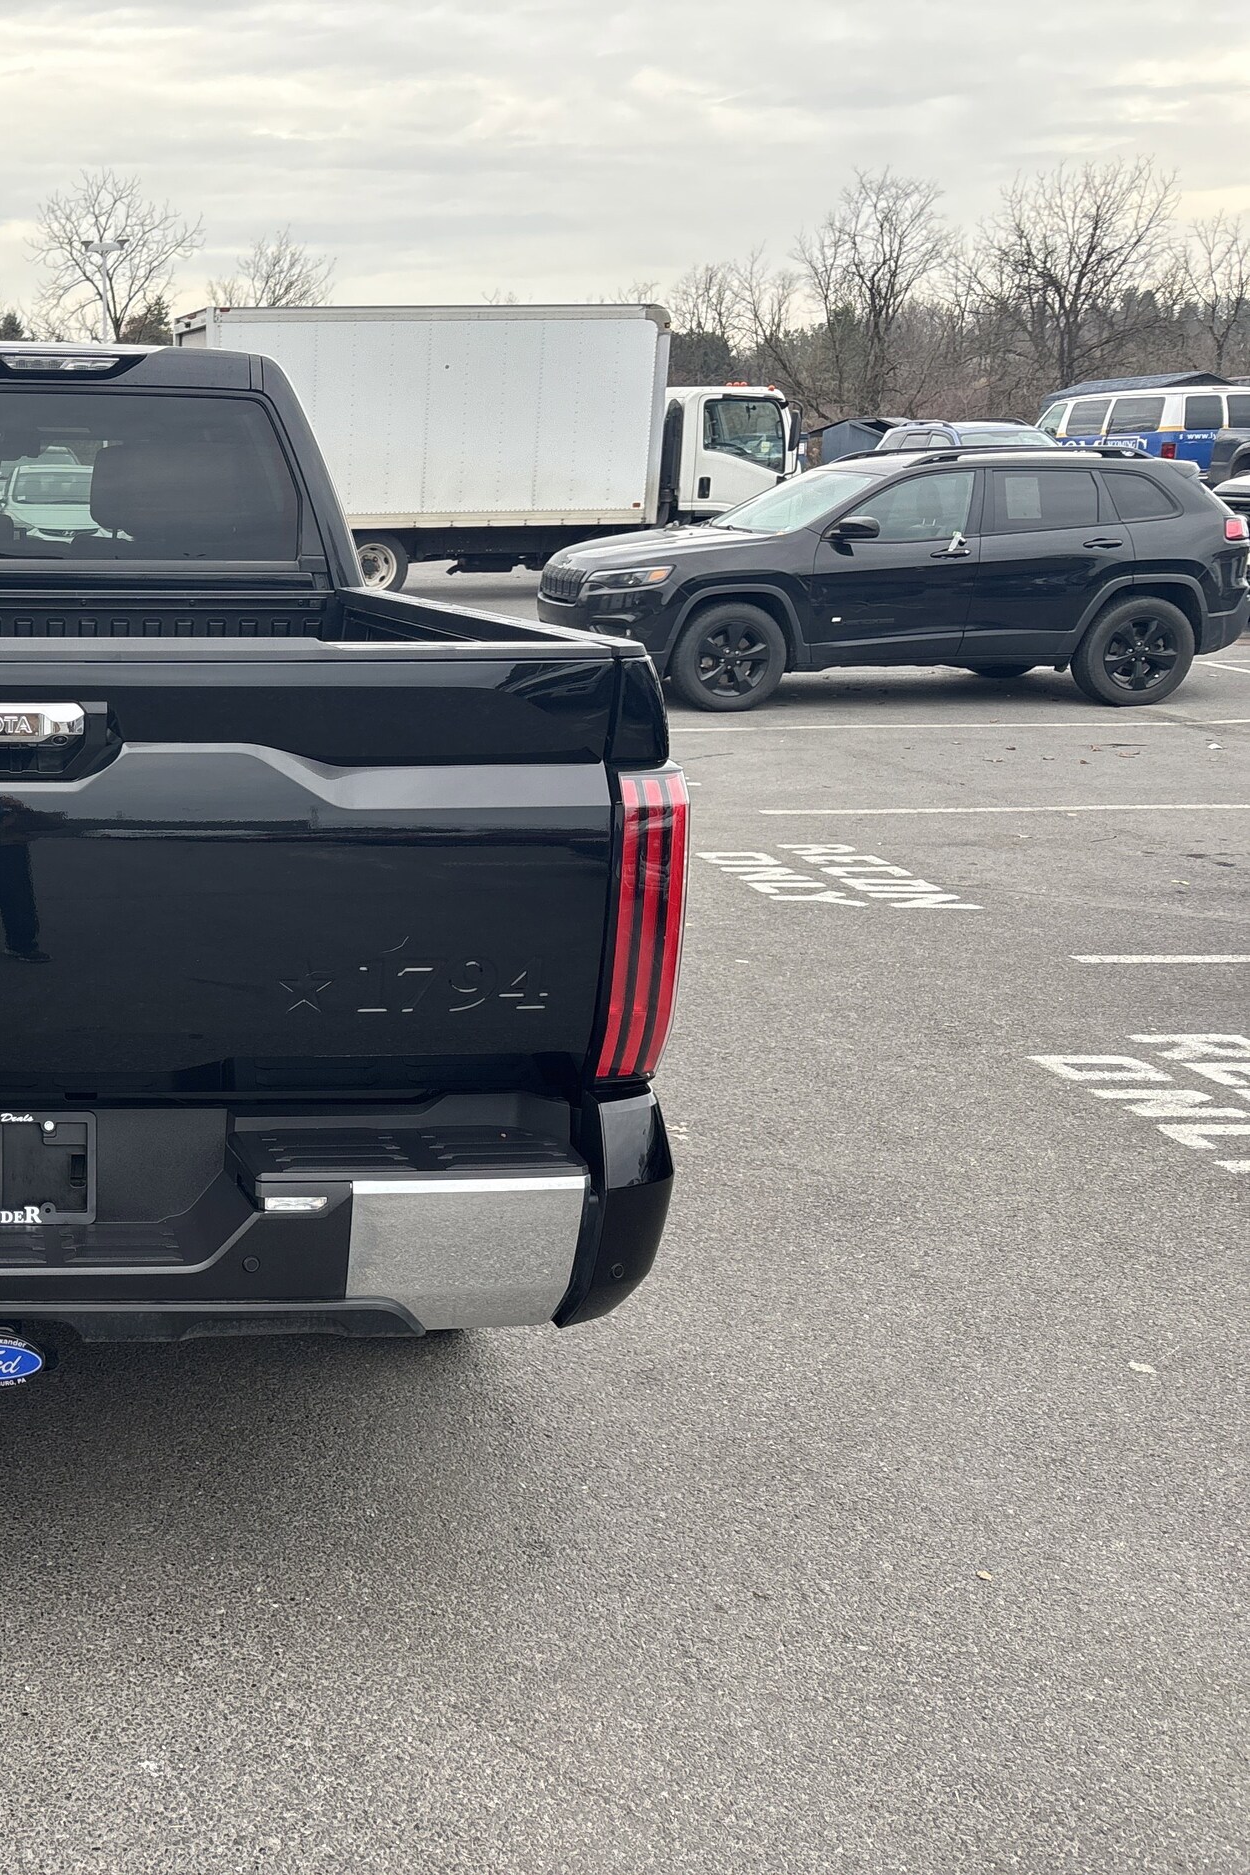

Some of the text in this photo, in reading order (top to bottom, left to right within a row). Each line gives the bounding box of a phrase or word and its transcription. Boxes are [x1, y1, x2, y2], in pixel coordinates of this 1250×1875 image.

[695, 851, 870, 906] ONLY
[776, 843, 985, 910] RECON
[356, 956, 549, 1013] 1794
[0, 1112, 34, 1122] Deals
[1024, 1054, 1250, 1174] ONL
[17, 1377, 27, 1385] PA
